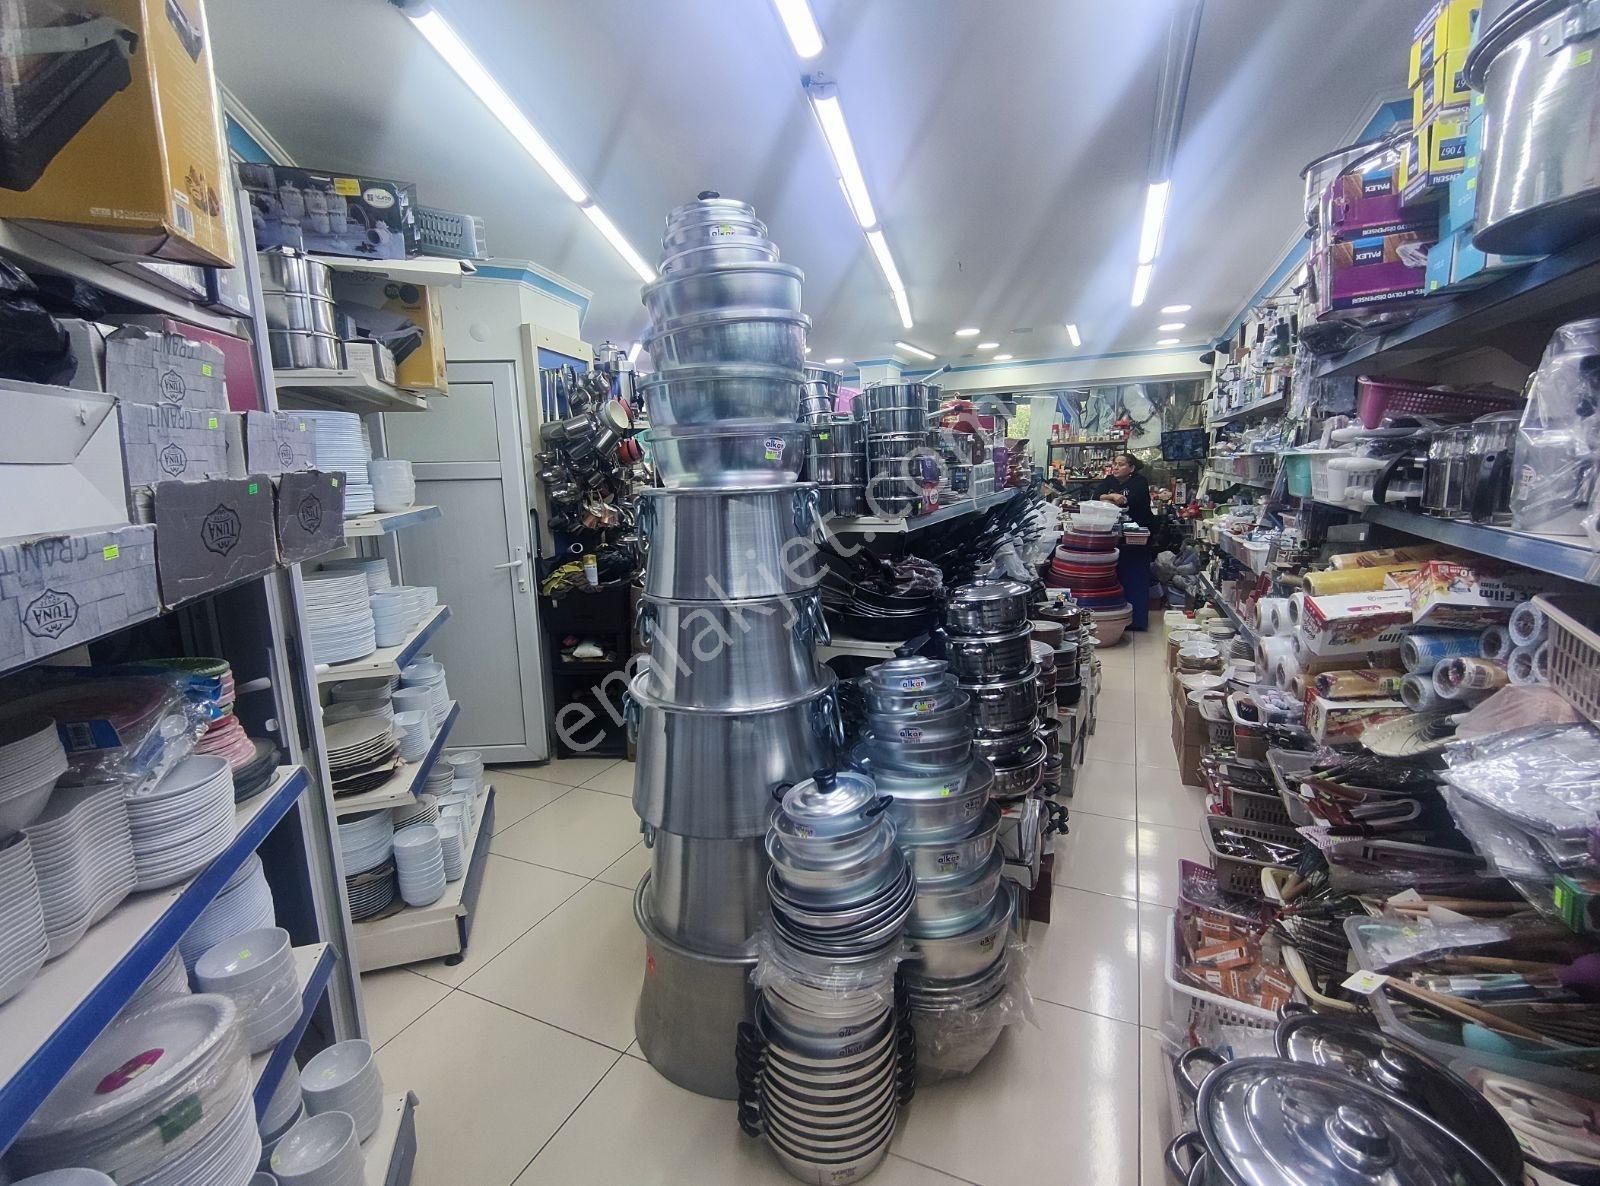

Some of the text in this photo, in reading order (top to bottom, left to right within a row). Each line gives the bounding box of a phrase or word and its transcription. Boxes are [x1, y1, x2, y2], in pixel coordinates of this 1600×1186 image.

[1441, 146, 1456, 156] 067
[1364, 182, 1390, 193] PALEX
[1355, 250, 1382, 261] PALEX
[1351, 293, 1387, 305] DİSPENSERİ
[1387, 291, 1406, 299] FOLYO
[164, 379, 182, 394] TUNA
[765, 440, 784, 450] alkar
[164, 454, 184, 467] TUNA
[302, 507, 320, 522] TUNA
[207, 519, 237, 540] TUNA
[1481, 582, 1500, 590] Film
[1479, 589, 1515, 603] Film
[32, 602, 72, 626] TUNA
[1378, 633, 1406, 644] ilm
[902, 678, 924, 688] alkar
[899, 728, 923, 738] alkar
[938, 854, 961, 864] alkar
